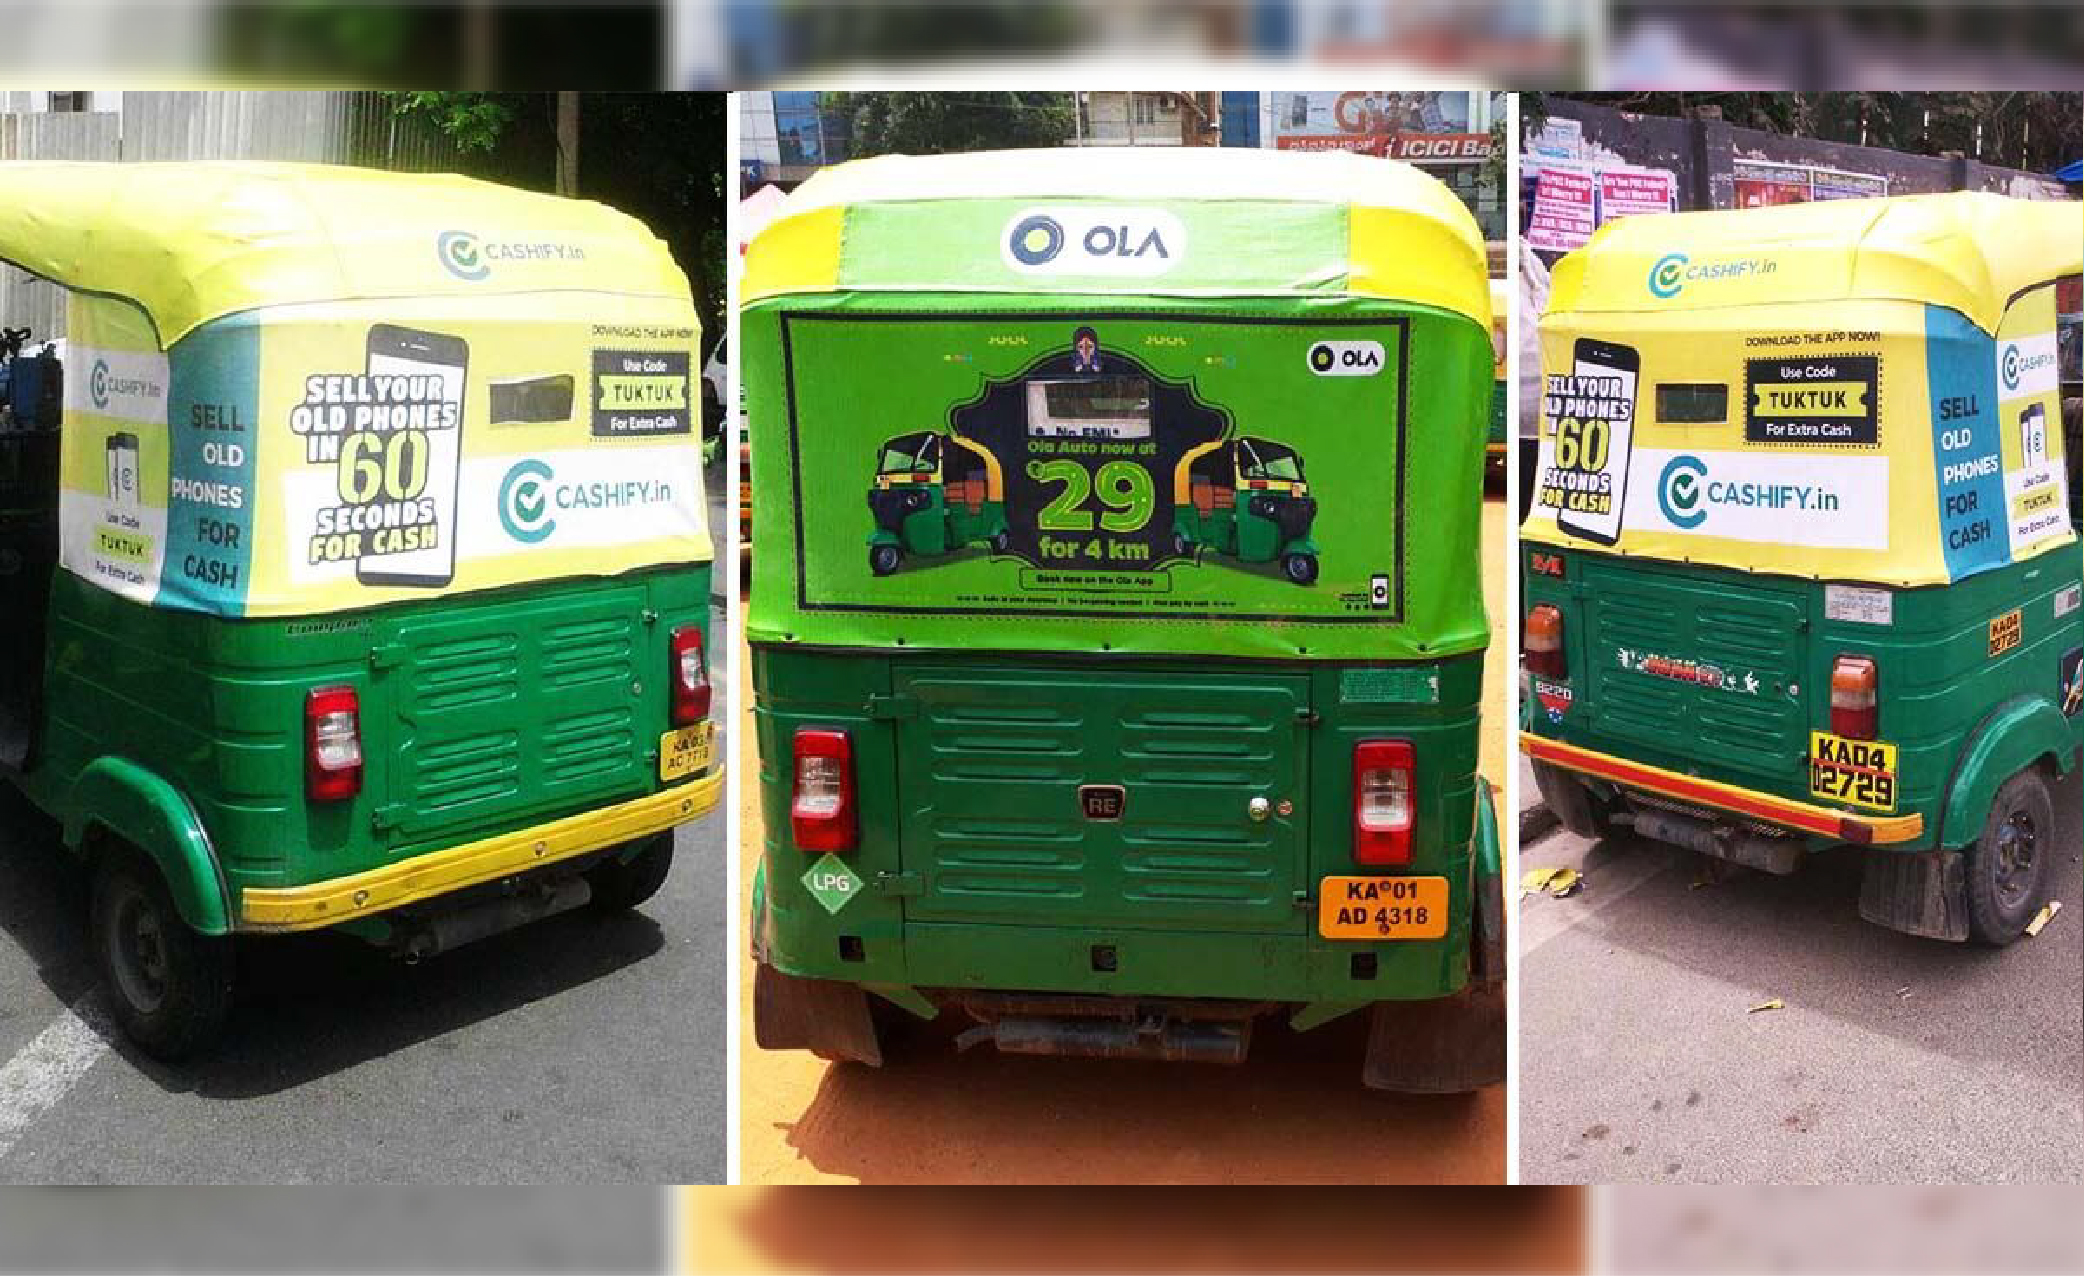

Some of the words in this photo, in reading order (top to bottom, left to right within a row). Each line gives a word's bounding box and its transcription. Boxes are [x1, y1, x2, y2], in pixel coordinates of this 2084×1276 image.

[1401, 140, 1457, 156] ICICI
[485, 243, 585, 260] CASHIFY.in
[1083, 225, 1168, 258] OLA
[1686, 258, 1777, 280] CASHIFY.in
[1746, 336, 1801, 347] DOWNLOAD
[1803, 334, 1822, 344] THE
[1825, 333, 1846, 342] APP
[622, 358, 642, 371] Use
[643, 359, 668, 372] Code
[1341, 349, 1379, 367] OLA
[1780, 367, 1802, 378] Use
[1805, 365, 1836, 378] Code
[306, 375, 373, 403] SELL
[373, 375, 444, 402] YOUR
[614, 384, 673, 402] TUKTUK
[1576, 377, 1622, 397] YOUR
[1565, 398, 1631, 420] PHONES
[1769, 390, 1847, 410] TUKTUK
[1940, 394, 1979, 421] SELL
[192, 404, 245, 431] SELL
[291, 404, 347, 434] OLD
[354, 402, 457, 430] PHONES
[610, 416, 628, 430] For
[629, 417, 654, 430] Extra
[655, 416, 678, 429] Cash
[1766, 423, 1785, 436] For
[1787, 423, 1818, 436] Extra
[1820, 423, 1852, 436] Cash
[1028, 441, 1055, 453] Ola
[1058, 441, 1098, 454] Auto
[1101, 443, 1135, 454] now
[1138, 441, 1157, 454] at
[1555, 417, 1610, 472] 60
[1941, 428, 1972, 451] OLD
[204, 442, 245, 467] OLD
[307, 434, 340, 463] IN
[338, 429, 429, 505] 60
[1943, 453, 2000, 485] PHONES
[171, 476, 243, 509] PHONES
[1544, 468, 1611, 493] SECONDS
[555, 480, 671, 510] CASHIFY.in
[1569, 491, 1611, 514] CASH
[1706, 481, 1839, 511] CASHIFY.in
[1946, 490, 1979, 519] FOR
[317, 498, 436, 535] SECONDS
[100, 533, 143, 557] TUKTUK
[197, 518, 241, 549] FOR
[309, 534, 362, 564] FOR
[372, 524, 438, 555] CASH
[1949, 519, 1991, 550] CASH
[1040, 535, 1080, 559] for
[1084, 538, 1102, 560] 4
[1108, 539, 1150, 561] km
[184, 555, 239, 589] CASH
[1089, 798, 1116, 813] RE
[813, 873, 849, 891] LPG
[1347, 882, 1379, 899] KA
[1393, 881, 1417, 898] 01
[1336, 907, 1368, 924] AD
[1374, 906, 1428, 925] 4318
